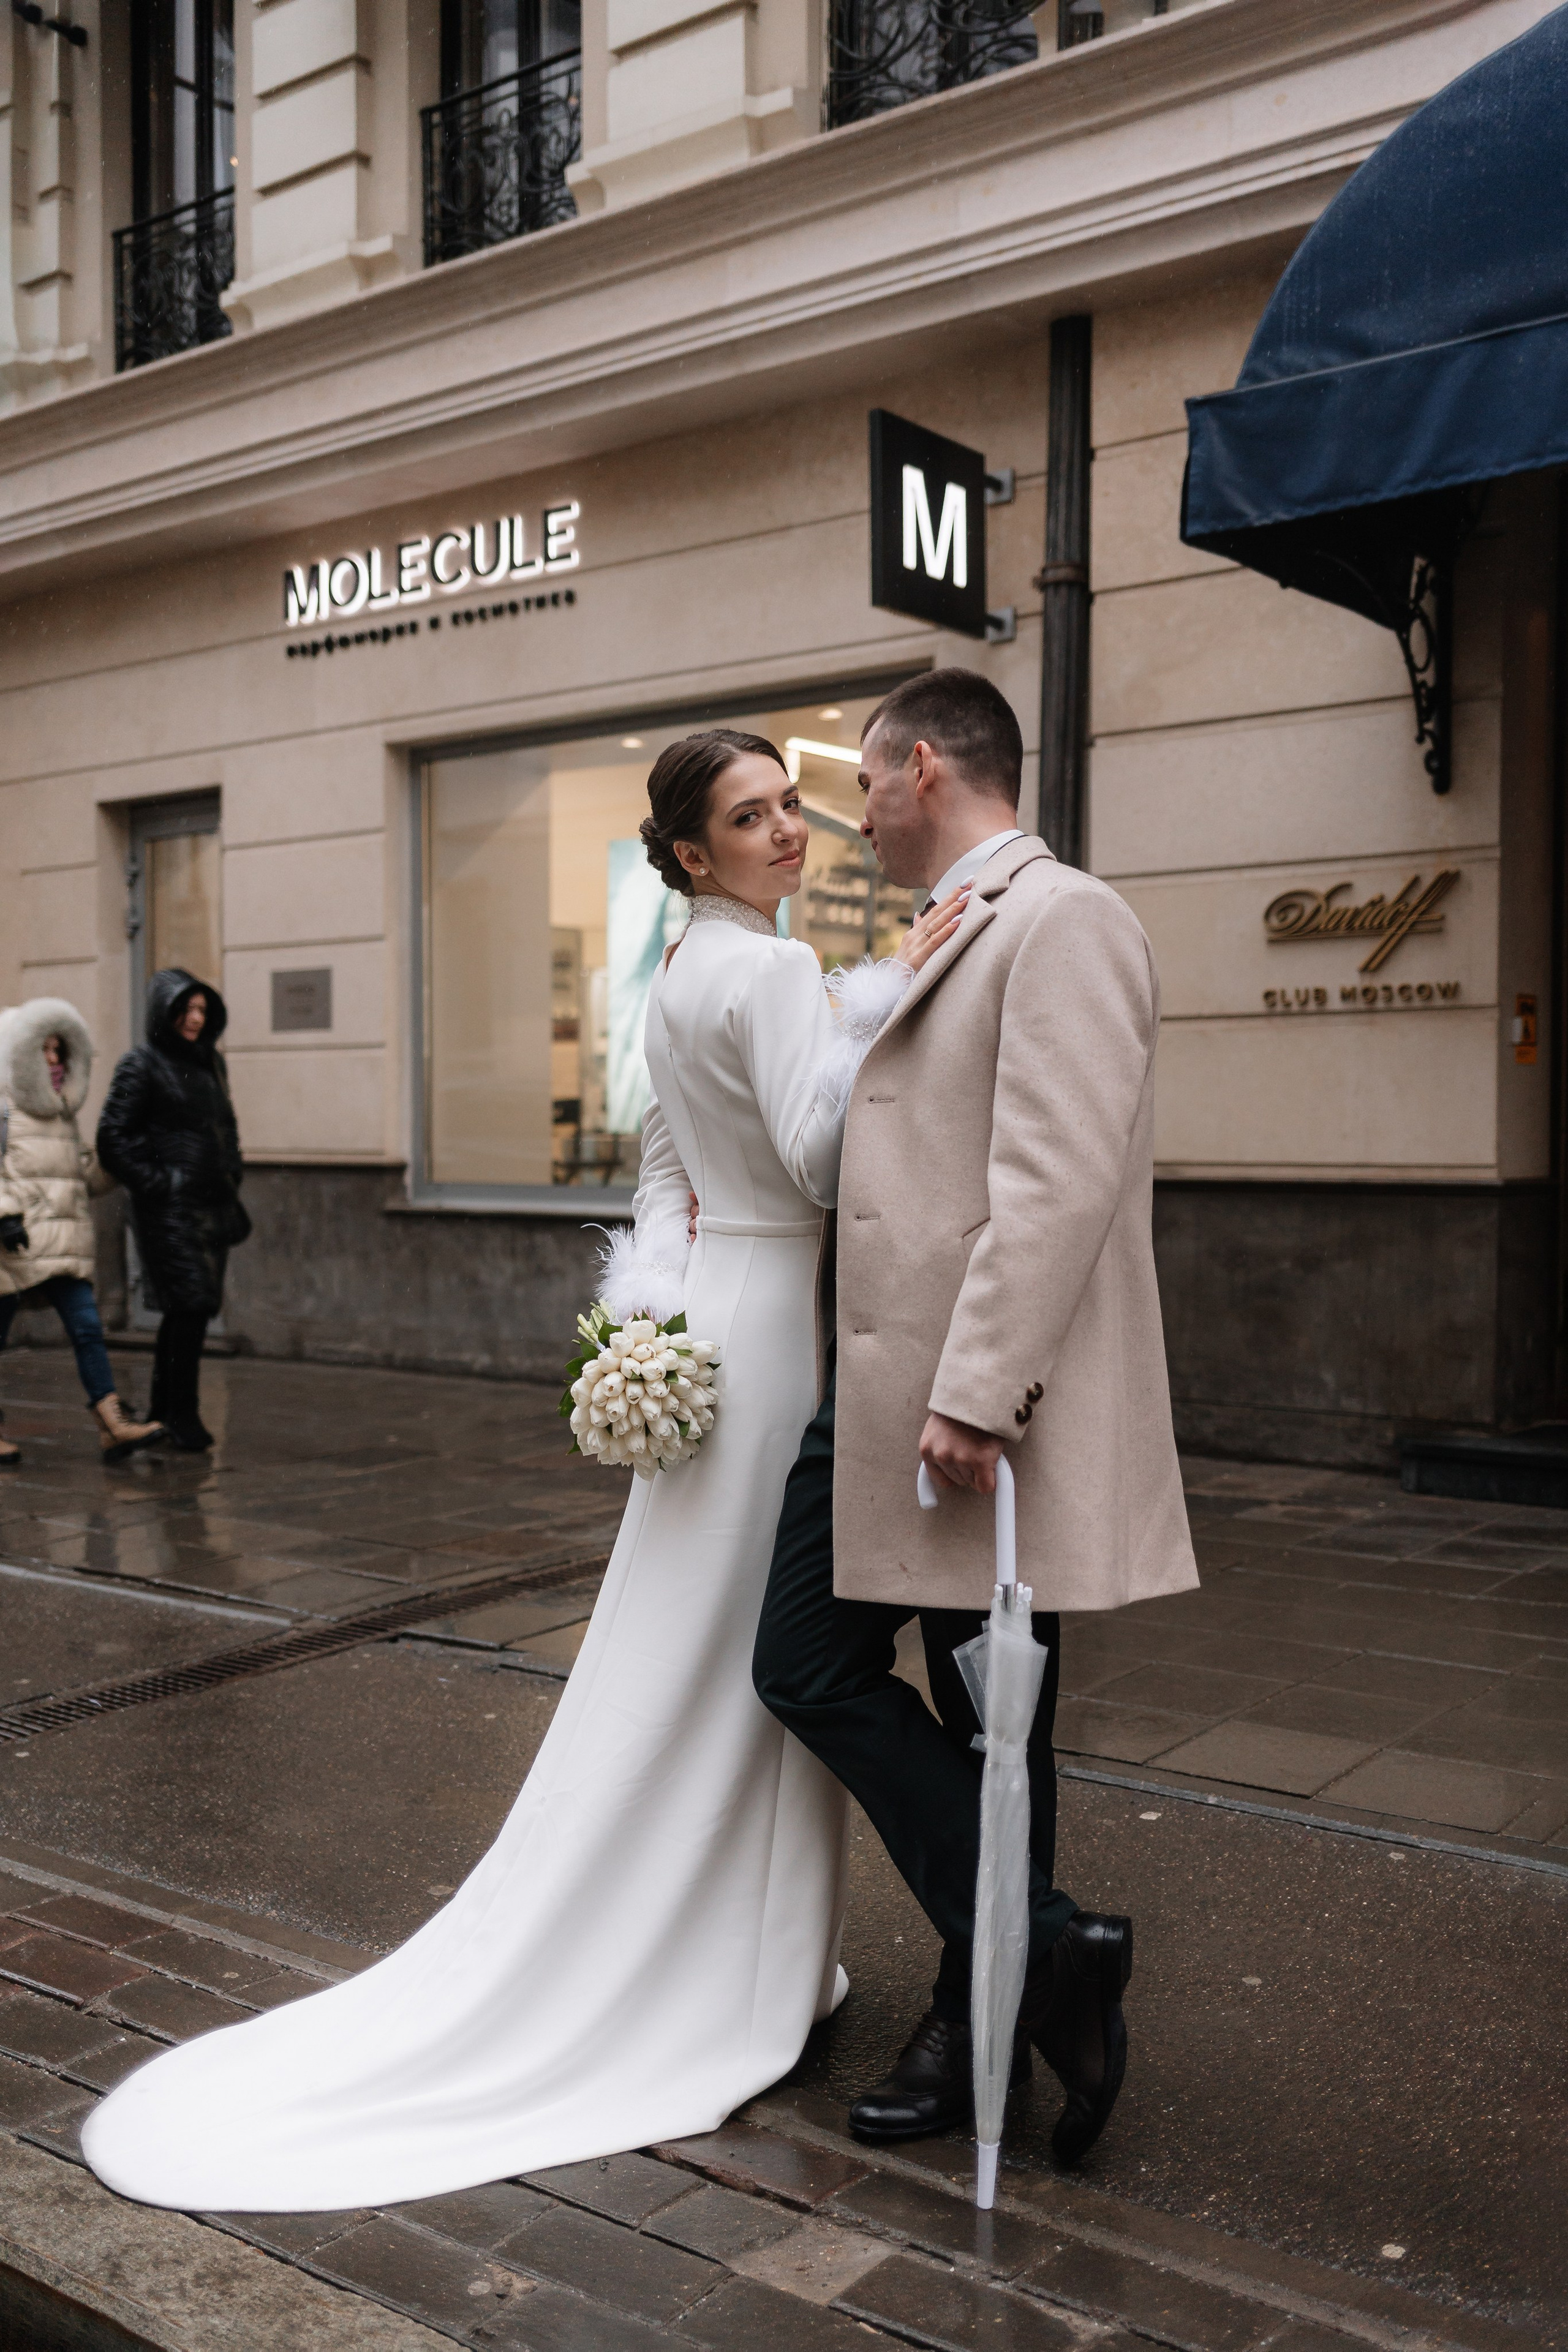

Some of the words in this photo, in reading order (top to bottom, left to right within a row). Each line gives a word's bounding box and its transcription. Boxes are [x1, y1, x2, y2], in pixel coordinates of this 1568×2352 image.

[284, 500, 579, 627] MOLECULE
[902, 464, 967, 589] M
[1262, 985, 1327, 1008] CLUB
[1339, 981, 1460, 1005] MOSCOW
